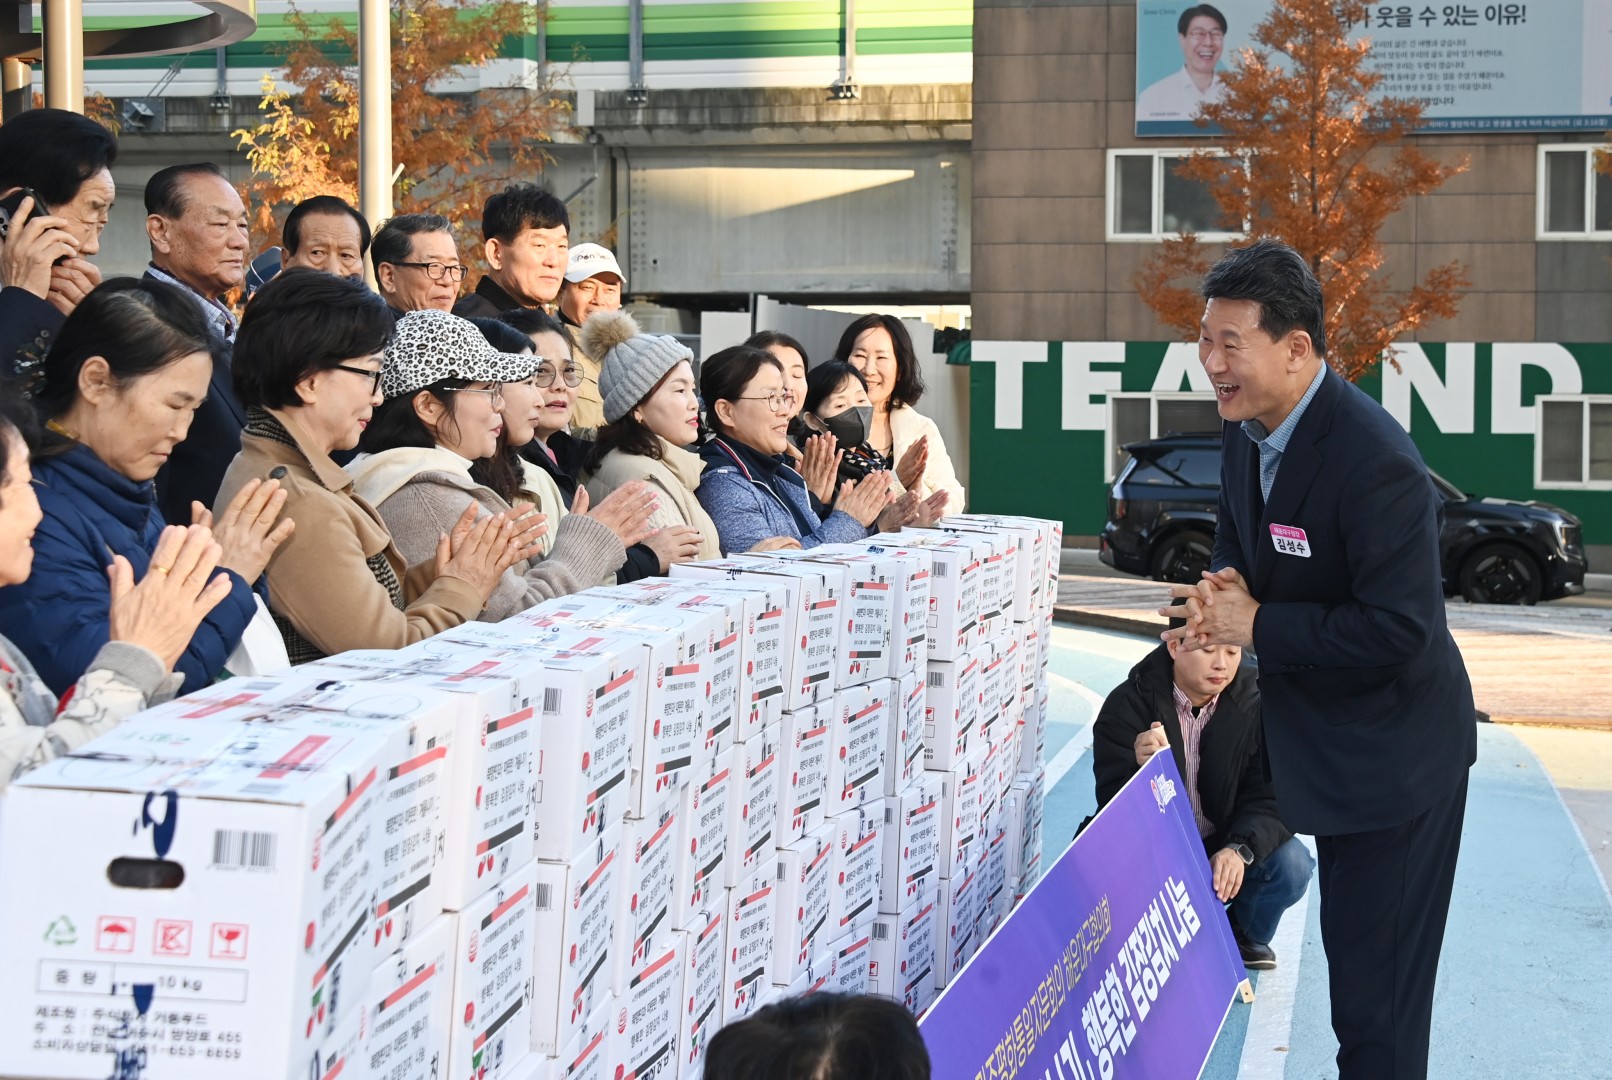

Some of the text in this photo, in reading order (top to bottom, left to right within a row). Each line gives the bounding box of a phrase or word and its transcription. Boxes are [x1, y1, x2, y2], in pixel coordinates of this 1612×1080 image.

[1376, 7, 1413, 28] 웃을
[1418, 7, 1437, 27] 수
[1443, 5, 1480, 26] 있는
[1485, 4, 1527, 25] 이유!
[1276, 538, 1306, 554] 김성수
[1062, 893, 1112, 992] 해운대구협의회
[1081, 962, 1137, 1080] 행복한
[1117, 897, 1180, 1023] 김장김치
[1159, 875, 1202, 949] 나눔
